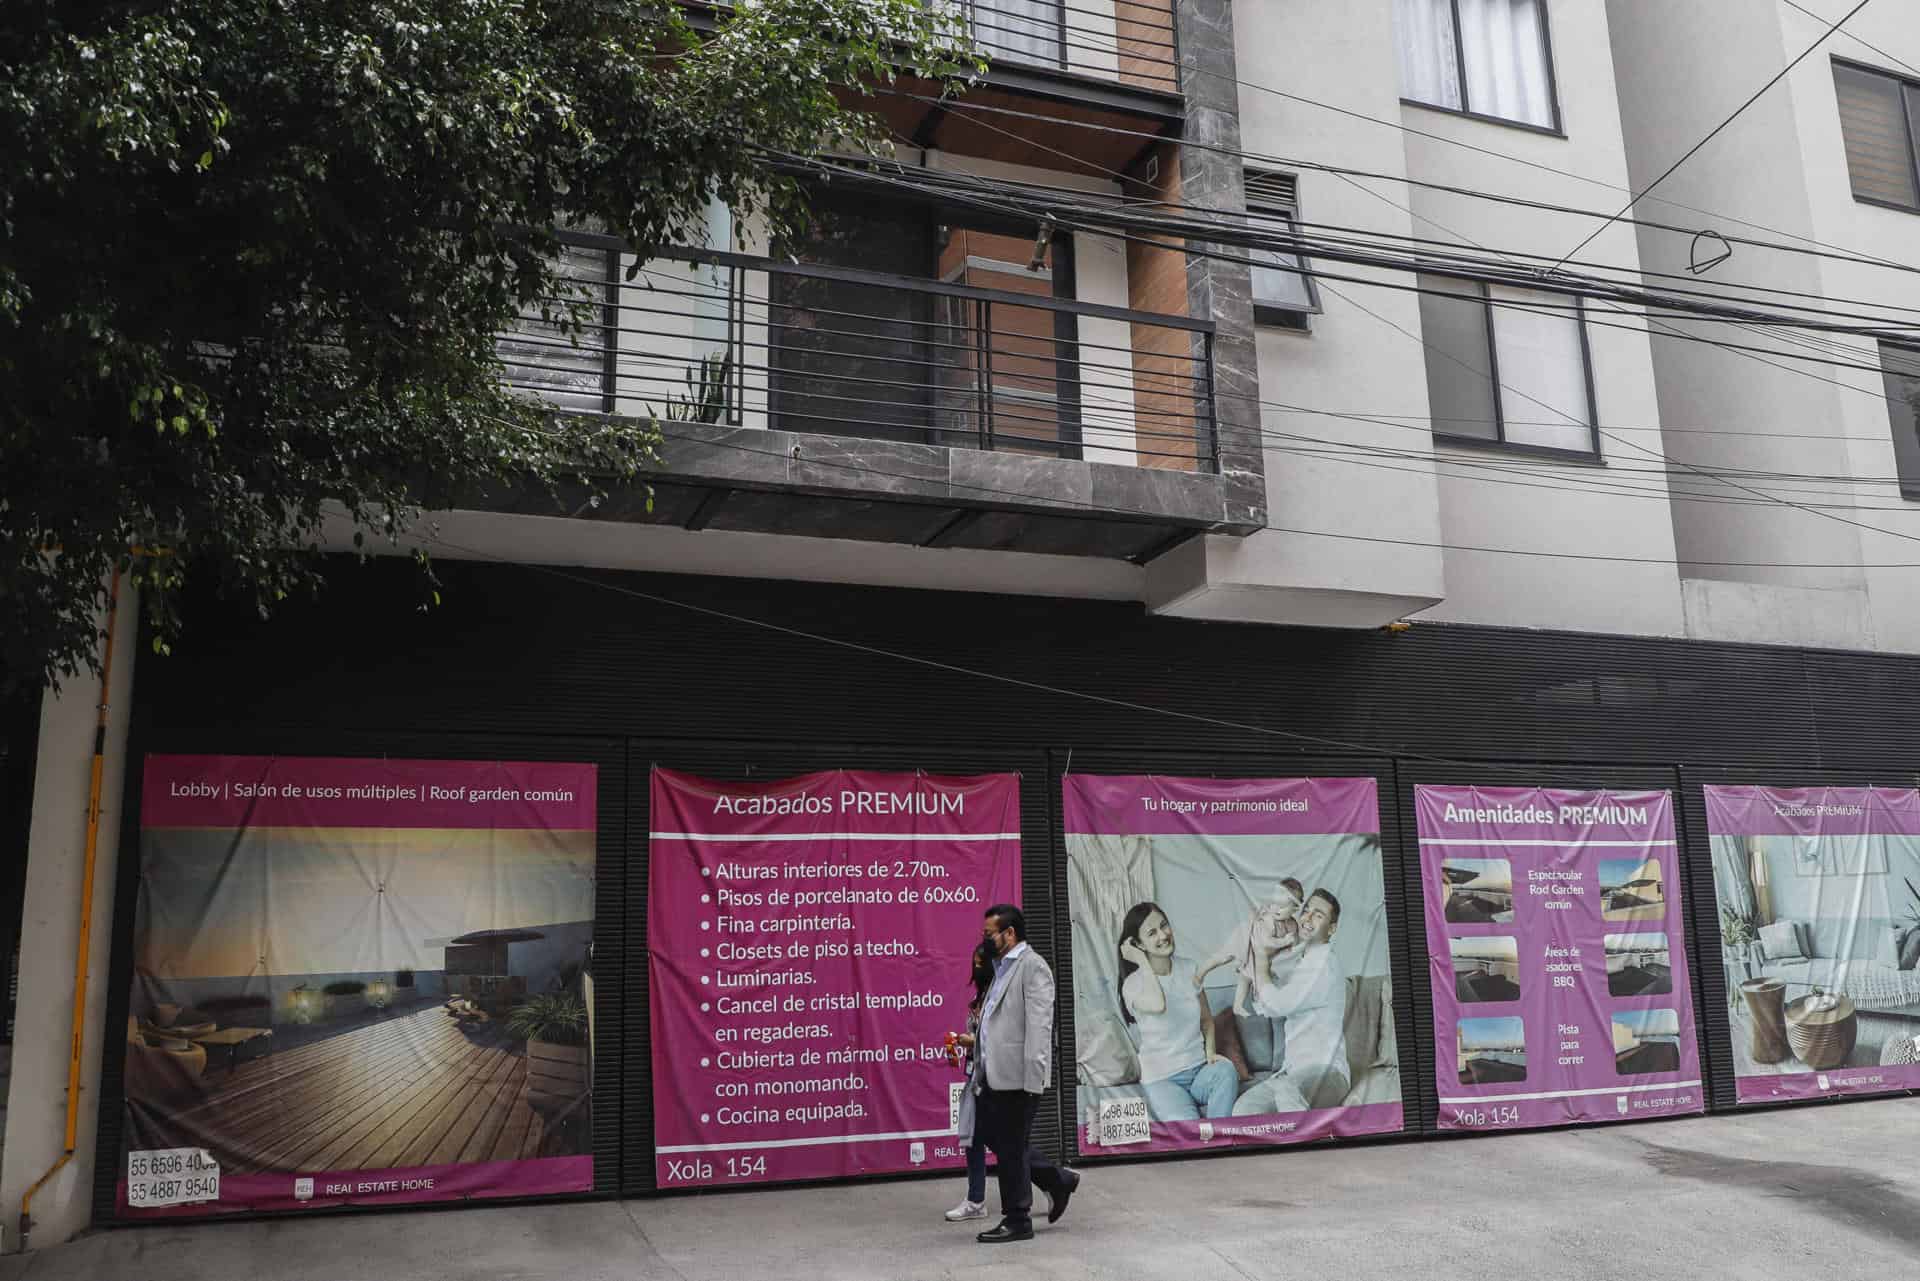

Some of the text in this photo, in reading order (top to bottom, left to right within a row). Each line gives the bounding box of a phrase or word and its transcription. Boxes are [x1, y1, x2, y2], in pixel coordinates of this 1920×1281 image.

[171, 782, 220, 799] Lobby
[234, 782, 277, 798] Salón
[281, 783, 301, 798] de
[306, 787, 342, 799] usos
[346, 784, 416, 801] múltiples
[430, 785, 465, 801] Roof
[469, 786, 520, 804] garden
[523, 787, 573, 802] común
[713, 791, 964, 816] Acabados PREMIUM
[1142, 797, 1309, 815] Tu hogar y patrimonio ideal
[1444, 803, 1647, 825] Amenidades PREMIUM
[716, 861, 950, 880] Alturas interiores de 2.70m.
[717, 887, 979, 910] Pisos de porcelanato de 60x60.
[1552, 884, 1584, 895] Garden
[717, 913, 856, 936] Fina carpintería.
[717, 940, 919, 961] Closets de piso a techo.
[717, 969, 817, 988] Luminarias.
[1554, 976, 1575, 988] BBQ
[717, 991, 943, 1015] Cancel de cristal templado
[715, 1022, 833, 1046] en regaderas.
[1558, 1023, 1579, 1035] Pista
[717, 1050, 795, 1070] Cubierta
[801, 1047, 821, 1065] de
[826, 1044, 889, 1064] mármol
[894, 1048, 915, 1062] en
[1560, 1040, 1579, 1053] para
[715, 1073, 869, 1098] con monomando.
[717, 1101, 867, 1126] Cocina equipada.
[1123, 1102, 1145, 1117] 4039
[1454, 1107, 1520, 1127] Xola 154
[1125, 1121, 1148, 1137] 9540
[934, 1147, 957, 1158] REAL
[131, 1158, 147, 1176] 55
[151, 1155, 182, 1175] 6596
[667, 1156, 767, 1181] Xola 154
[131, 1176, 217, 1200] 55 4887 9540
[326, 1184, 353, 1195] REAL
[358, 1181, 399, 1193] ESTATE
[402, 1178, 434, 1191] HOME
